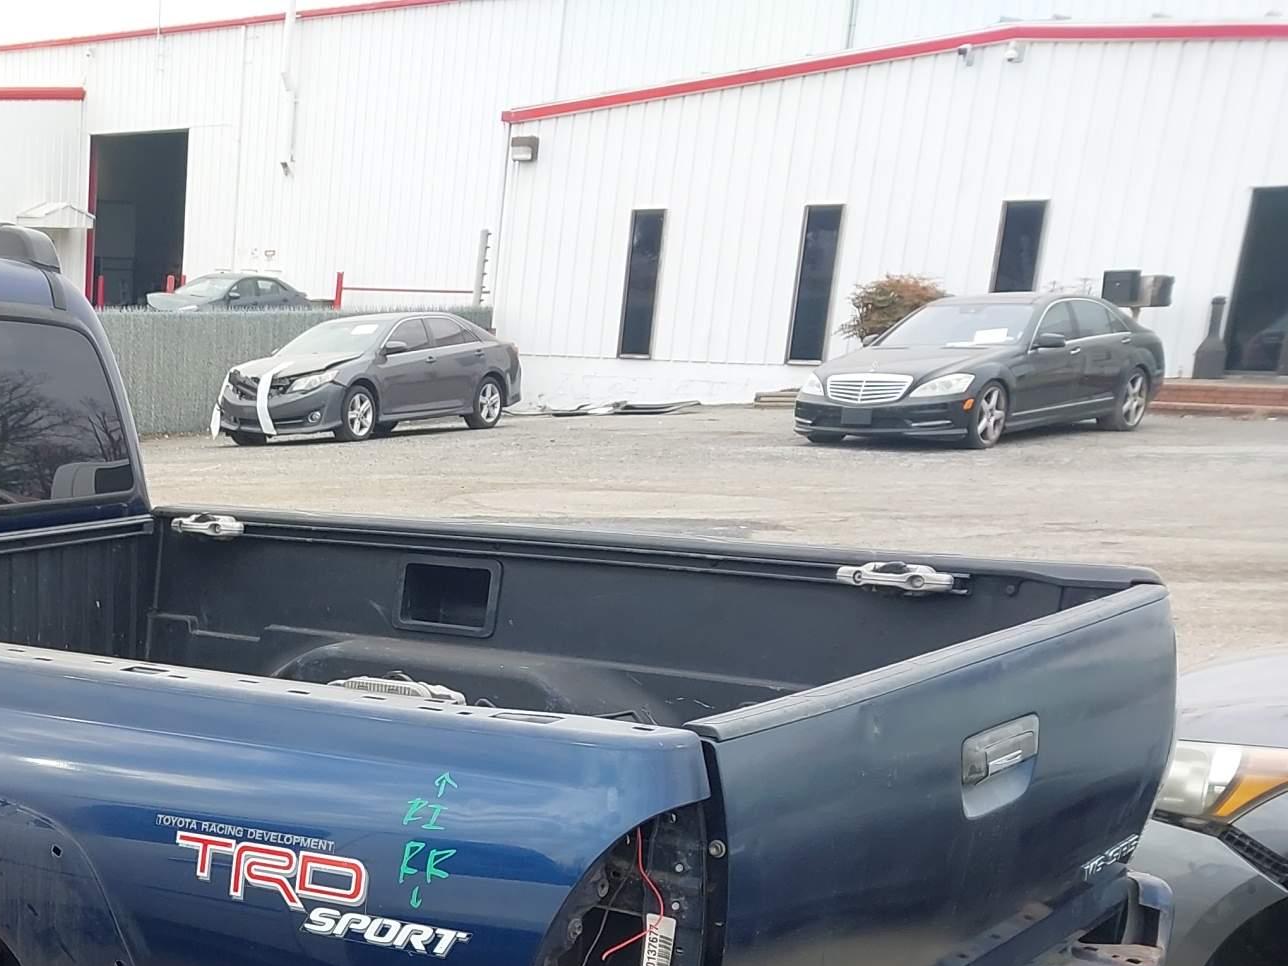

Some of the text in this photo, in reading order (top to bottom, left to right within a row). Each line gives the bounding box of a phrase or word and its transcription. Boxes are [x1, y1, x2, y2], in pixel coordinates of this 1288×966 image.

[157, 814, 335, 852] TOYOTA RACING DEVELOPMENT
[176, 830, 367, 912] TRD
[303, 907, 471, 957] SPORT
